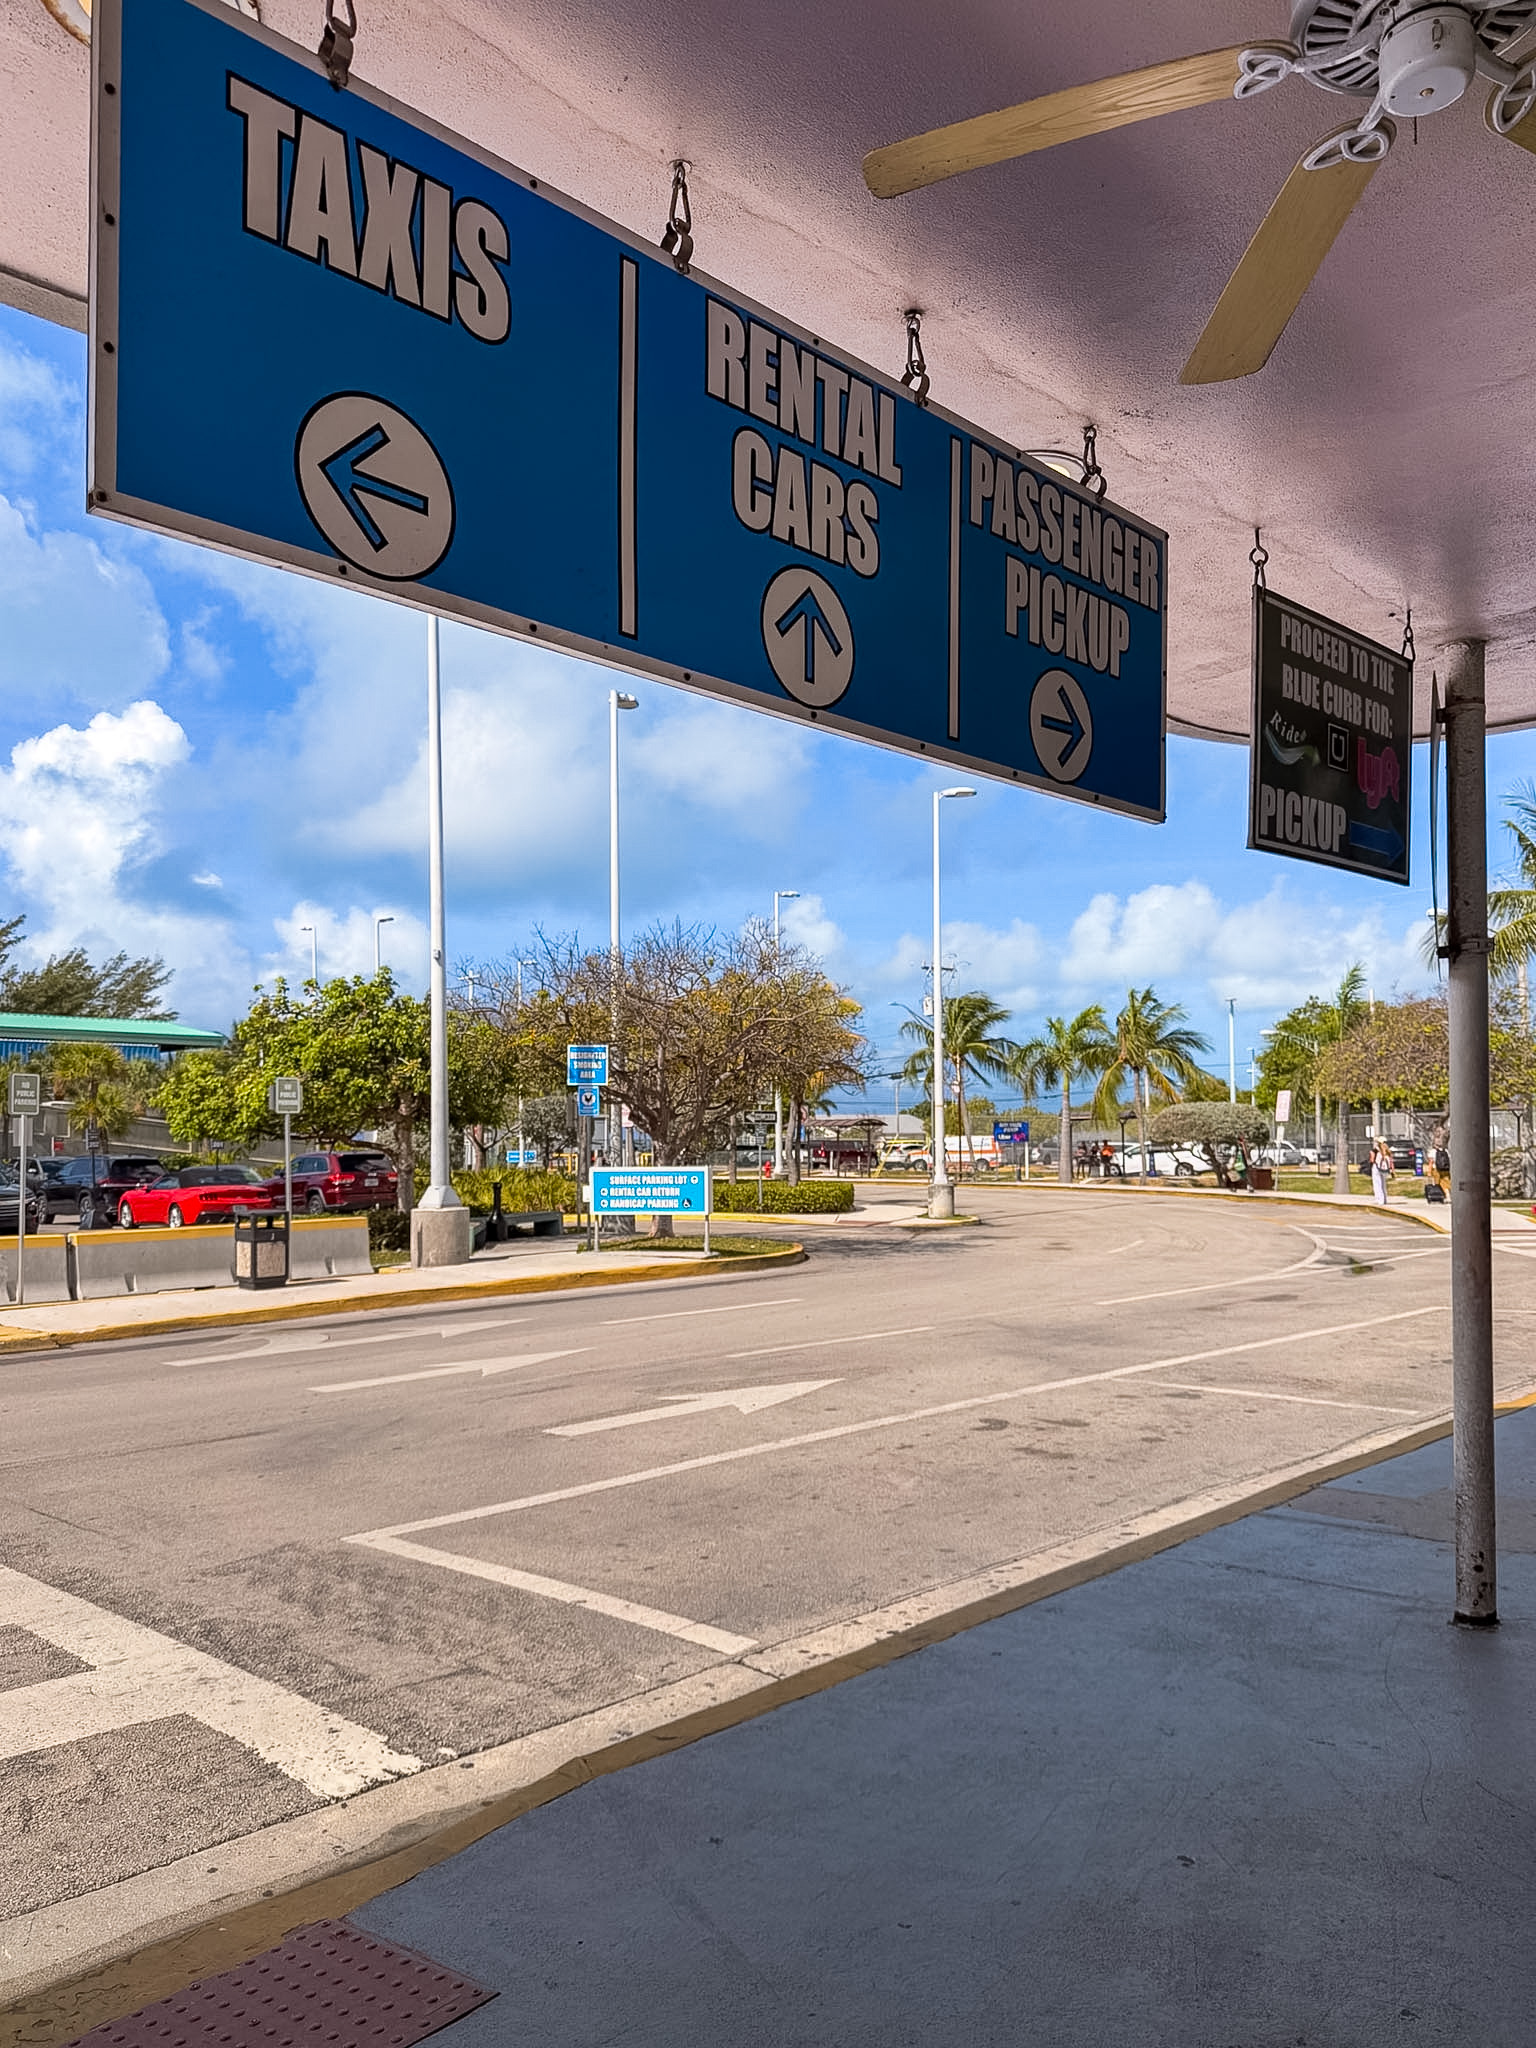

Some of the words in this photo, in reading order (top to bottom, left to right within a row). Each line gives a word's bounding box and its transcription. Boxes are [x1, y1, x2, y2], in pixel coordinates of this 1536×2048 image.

[226, 70, 511, 345] TAXIS
[705, 295, 903, 491] RENTAL
[732, 426, 880, 578] CARS
[969, 441, 1160, 611] PASSENGER
[1005, 554, 1130, 678] PICKUP
[1280, 613, 1348, 673] PROCEED
[1351, 647, 1368, 683] TO
[1370, 654, 1395, 695] THE
[1282, 664, 1320, 711] BLUE
[1323, 680, 1362, 726] CURB
[1365, 697, 1393, 739] FOR:
[1260, 784, 1347, 852] PICKUP
[609, 1175, 641, 1185] SURFACE
[642, 1175, 674, 1185] PARKING
[674, 1175, 687, 1185] LOT
[609, 1187, 635, 1197] RENTAL
[636, 1187, 651, 1197] CAR
[652, 1187, 680, 1197] RETURN
[647, 1198, 679, 1208] PARKING
